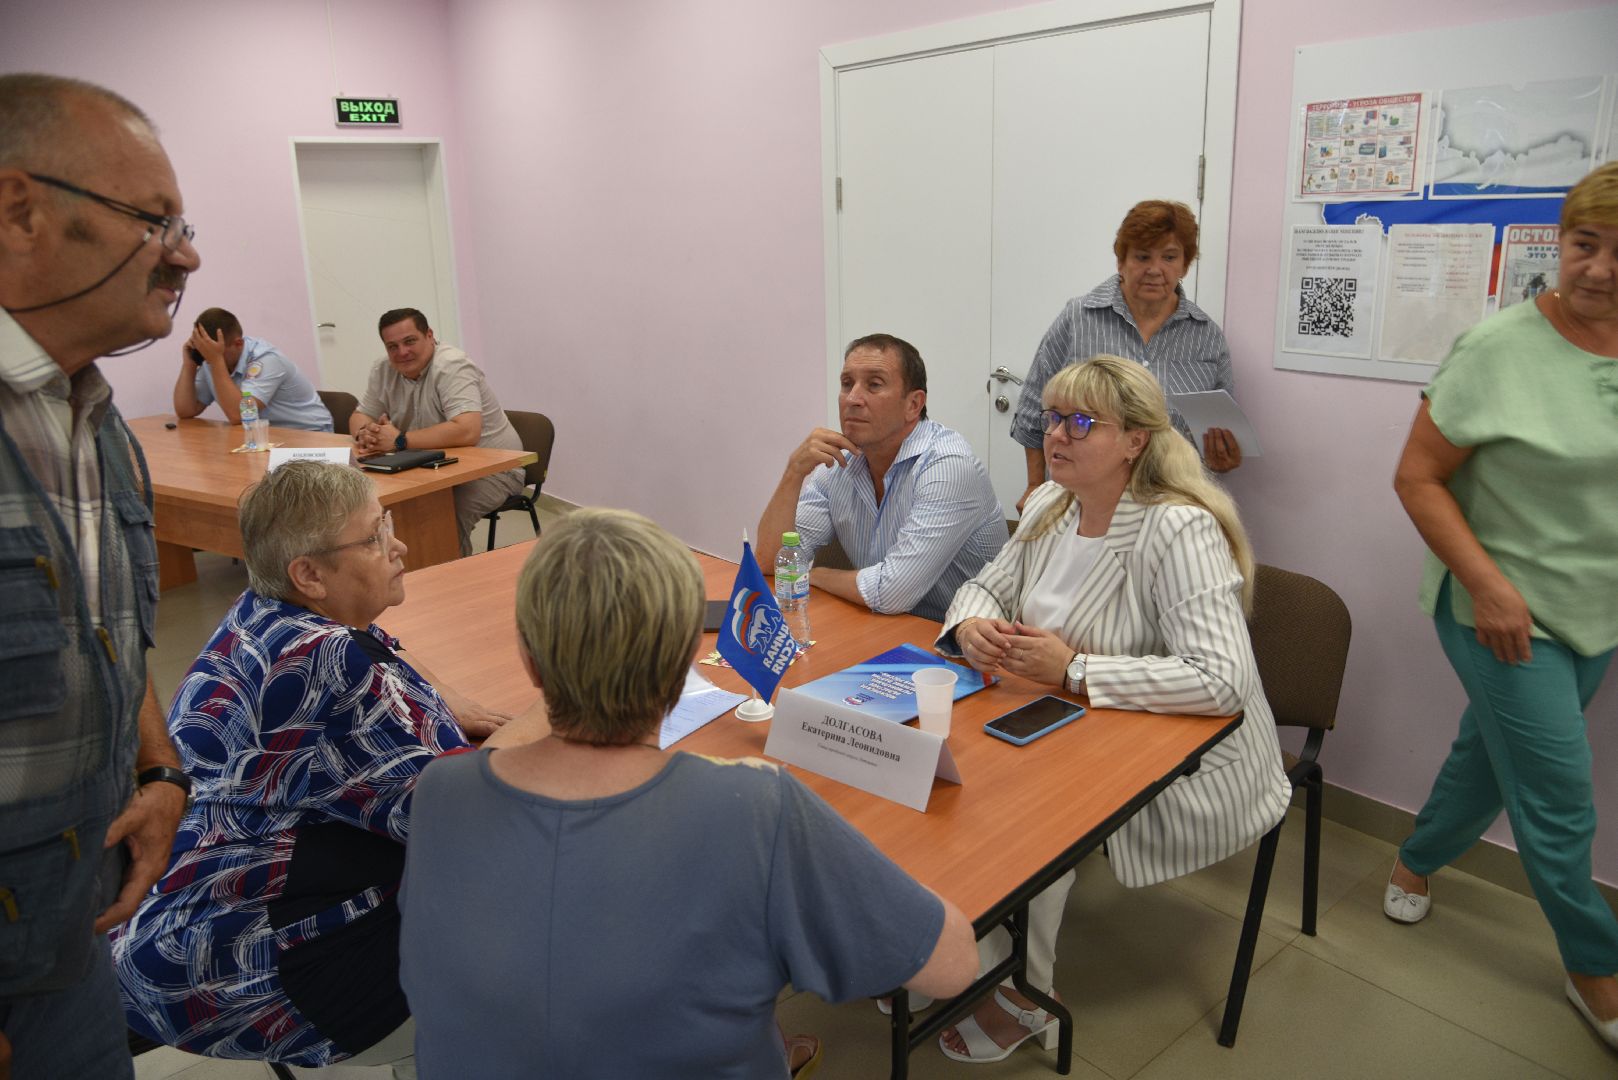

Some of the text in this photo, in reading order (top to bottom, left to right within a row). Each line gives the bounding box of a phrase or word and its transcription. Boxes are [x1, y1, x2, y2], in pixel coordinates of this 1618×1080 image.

[340, 101, 395, 115] ВЫХОД
[349, 113, 388, 122] EXIT
[821, 715, 883, 742] ДОЛГАСОВА
[801, 721, 846, 744] Екатерина
[847, 736, 901, 763] Леонидовна
